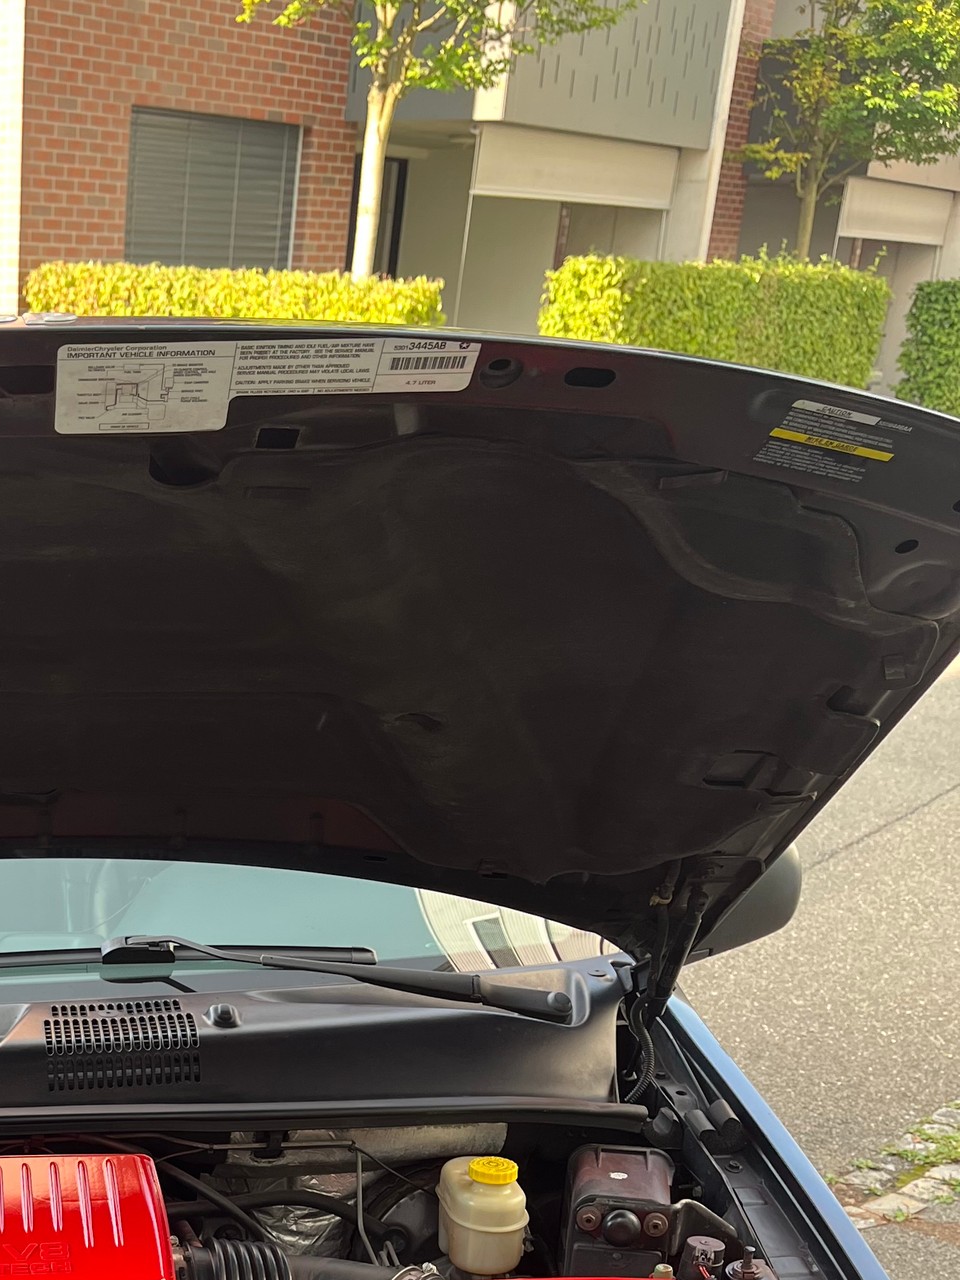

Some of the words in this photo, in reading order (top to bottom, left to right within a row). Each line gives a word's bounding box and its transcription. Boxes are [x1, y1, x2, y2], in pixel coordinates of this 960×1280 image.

[394, 342, 447, 351] 53013445AB
[821, 406, 853, 417] CAUTION
[2, 1242, 71, 1261] V8
